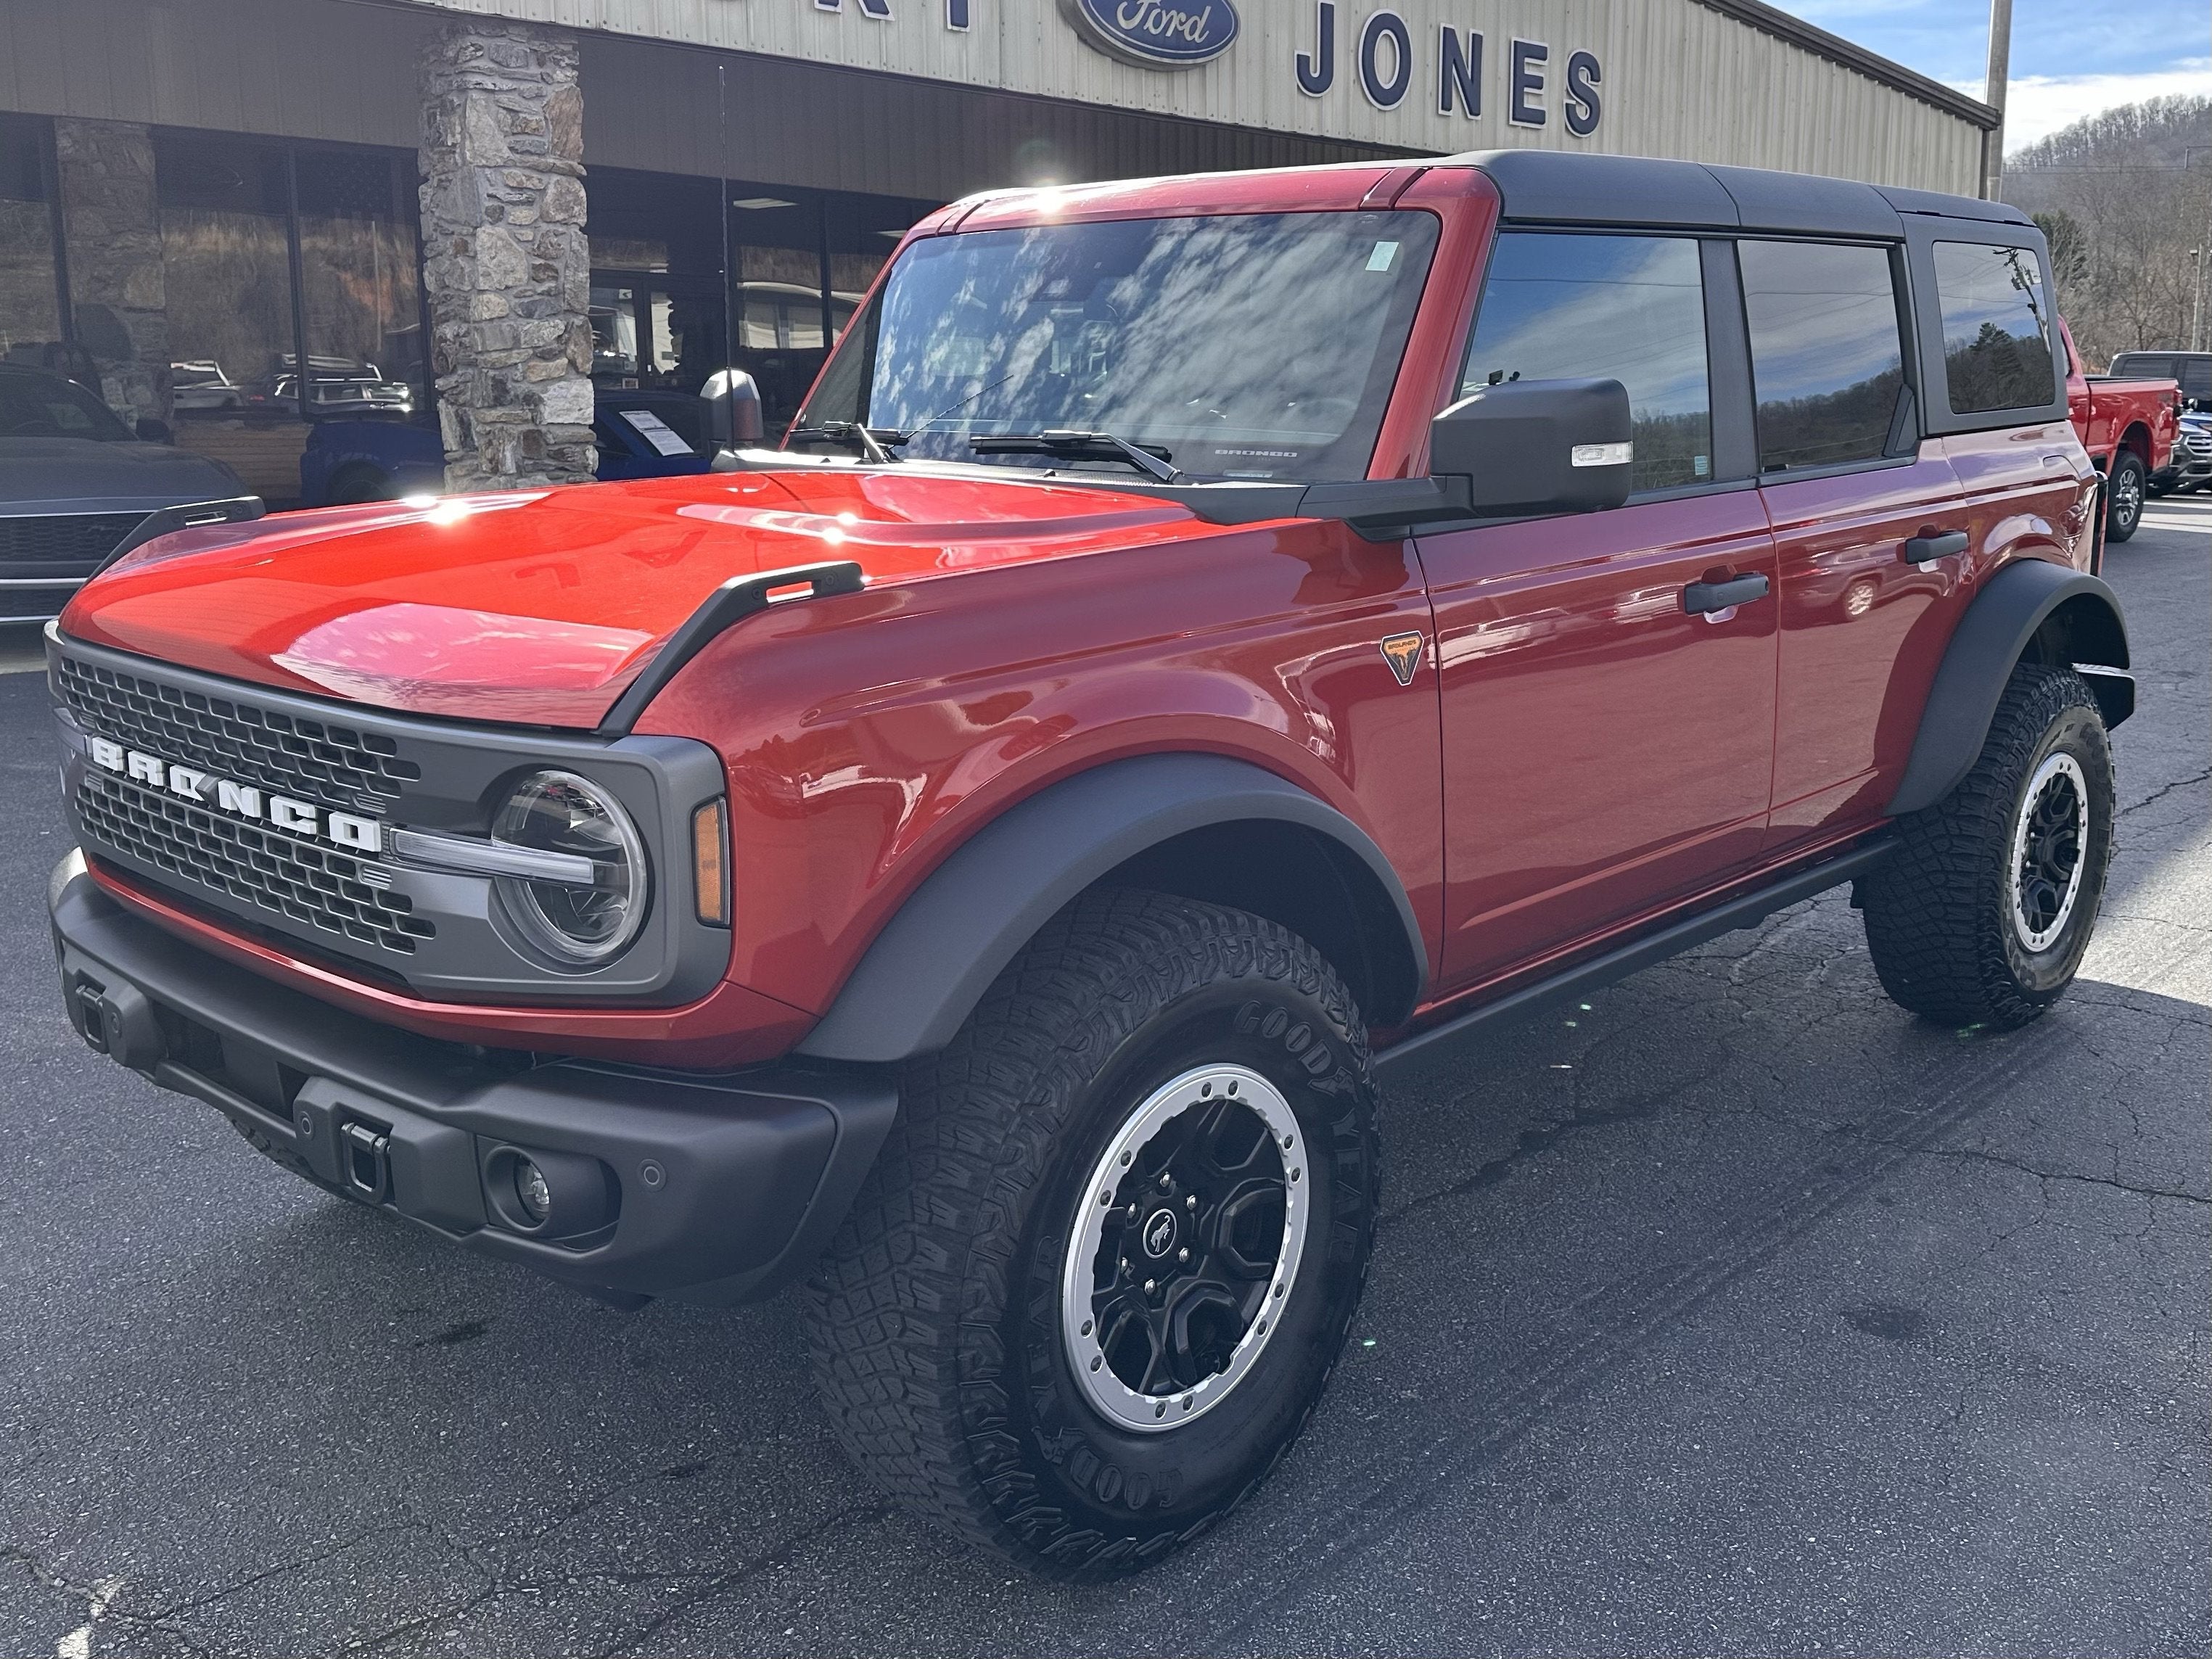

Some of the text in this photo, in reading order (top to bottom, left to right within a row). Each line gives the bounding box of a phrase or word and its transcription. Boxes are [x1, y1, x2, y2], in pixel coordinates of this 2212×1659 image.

[1294, 0, 1602, 139] JONES
[91, 736, 382, 853] BRONCO
[1234, 1000, 1362, 1262] GOODYEAR
